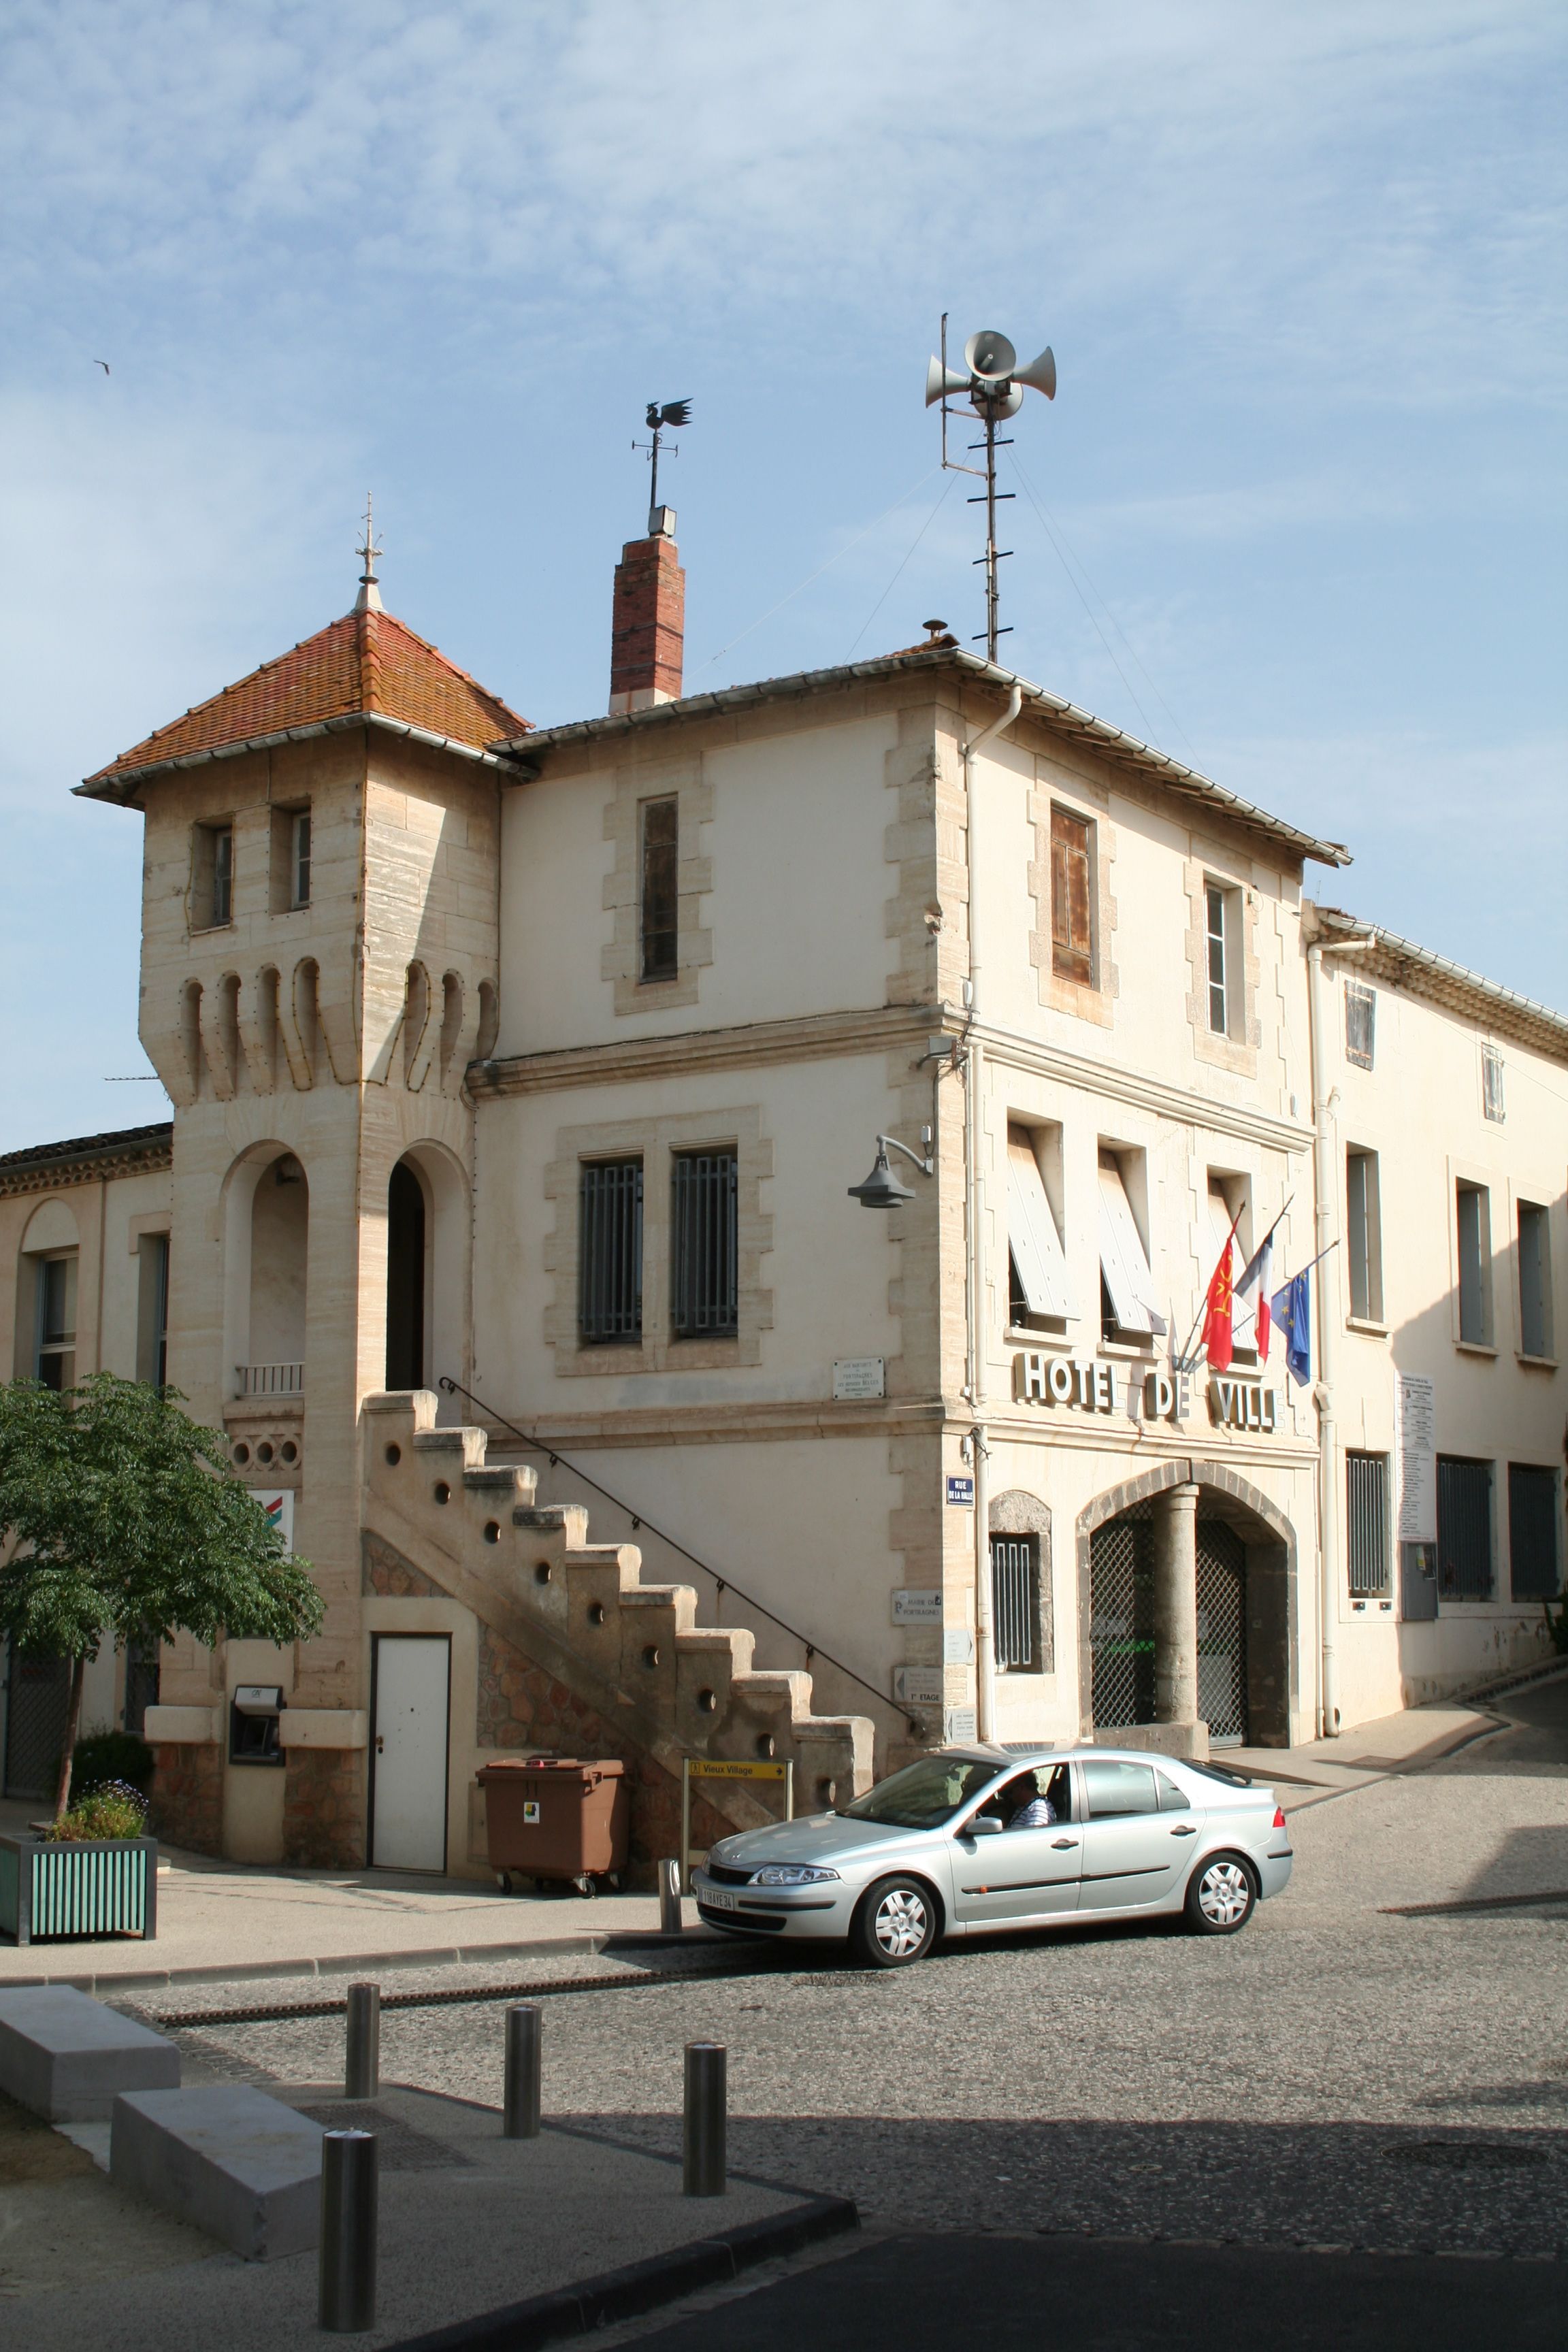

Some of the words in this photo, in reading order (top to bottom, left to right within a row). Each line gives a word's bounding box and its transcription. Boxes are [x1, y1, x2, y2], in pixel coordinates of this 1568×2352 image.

[1018, 1352, 1126, 1408] HOTEL
[1150, 1372, 1190, 1418] DE
[1213, 1380, 1286, 1428] VILLE
[955, 1480, 967, 1490] RUE
[949, 1490, 954, 1499] DE
[955, 1490, 960, 1499] LA
[961, 1491, 973, 1501] HALLE
[703, 1764, 725, 1774] Vieux
[726, 1764, 753, 1776] Village
